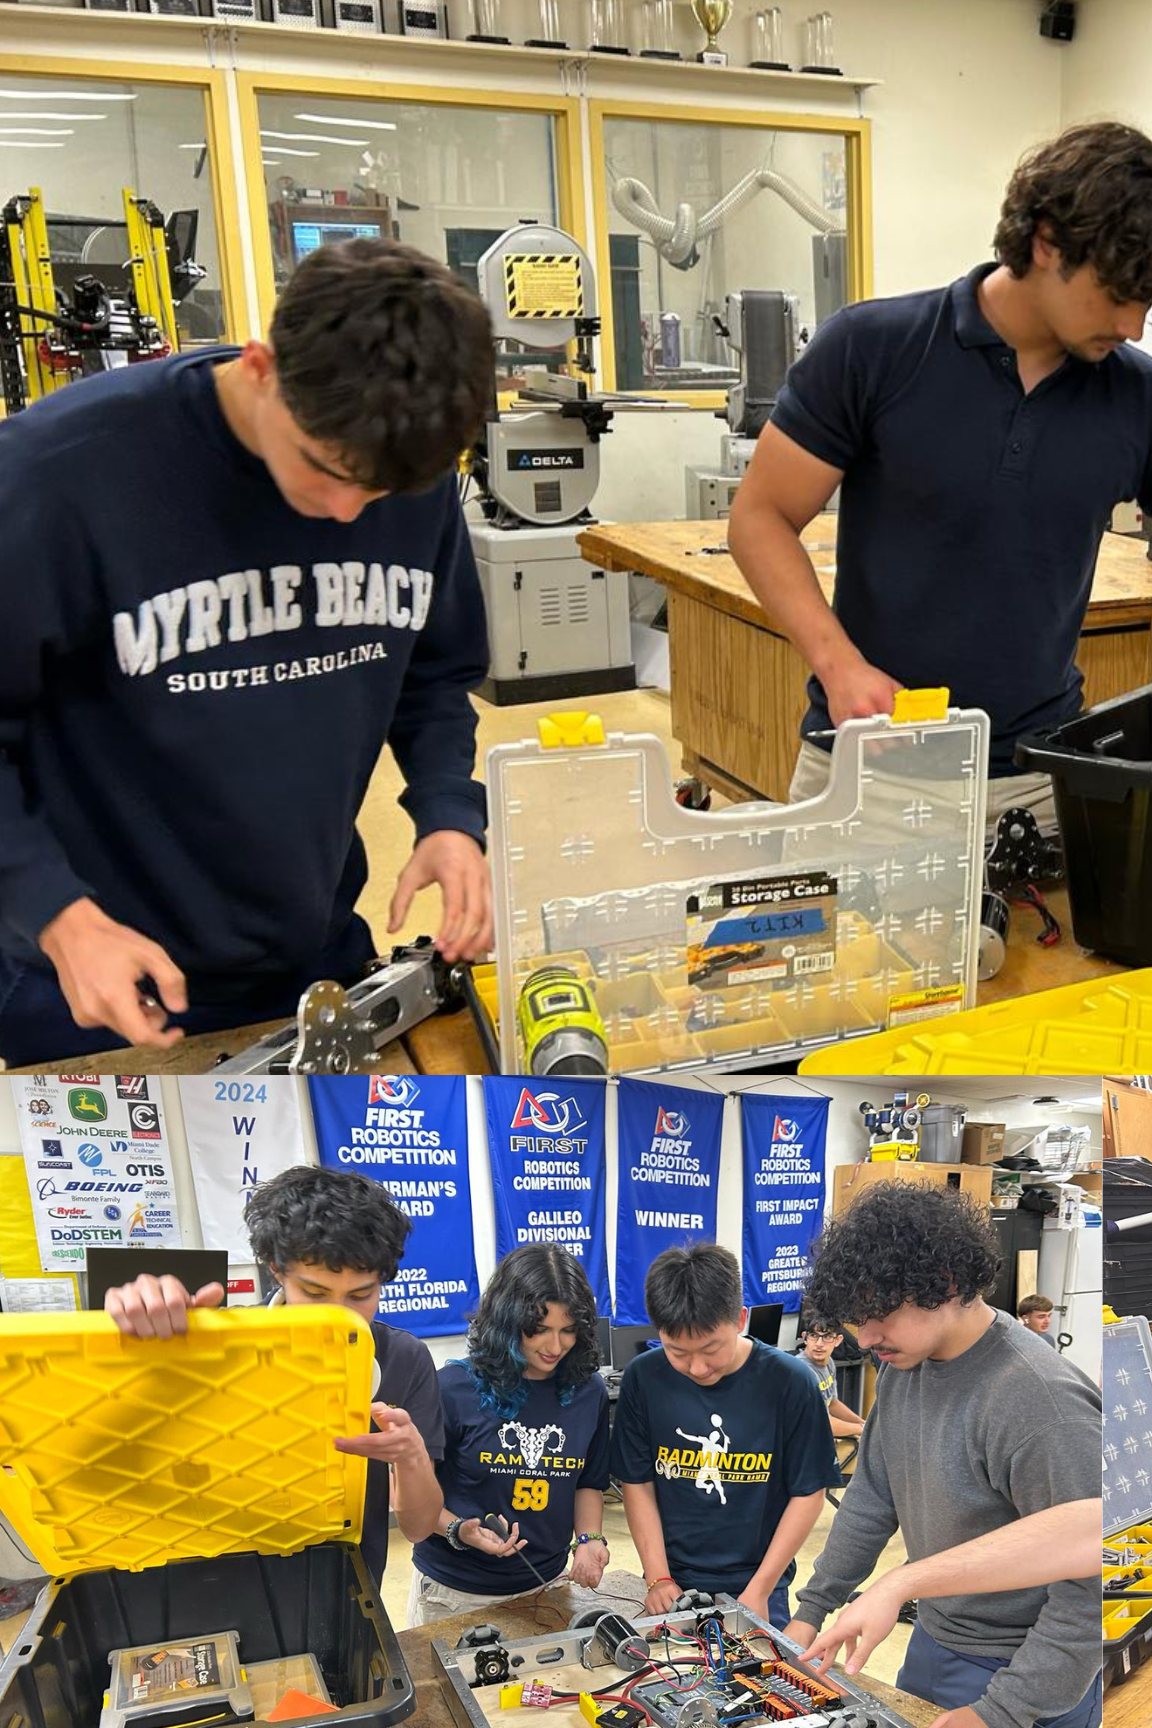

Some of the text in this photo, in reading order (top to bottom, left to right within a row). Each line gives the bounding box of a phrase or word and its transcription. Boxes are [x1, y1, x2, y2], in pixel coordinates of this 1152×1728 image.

[531, 456, 574, 467] DELTA
[113, 561, 434, 677] MYRTLE BEACH
[167, 641, 387, 693] SOUTH CAROLINA
[756, 881, 788, 891] Portable
[790, 878, 810, 887] Parts
[731, 889, 790, 905] Storage
[794, 883, 829, 897] Case
[214, 1081, 267, 1103] 2024
[366, 1108, 424, 1128] FIRST
[56, 1125, 128, 1138] JOHN DEERE
[351, 1128, 441, 1147] ROBOTICS
[510, 1136, 588, 1154] FIRST
[650, 1137, 692, 1155] FIRST
[770, 1143, 804, 1158] FIRST
[338, 1147, 457, 1166] COMPETITION
[640, 1152, 700, 1171] ROBOTICS
[92, 1168, 117, 1176] FPL
[126, 1164, 165, 1177] OTIS
[524, 1160, 580, 1175] ROBOTICS
[761, 1158, 811, 1171] ROBOTICS
[513, 1176, 591, 1190] COMPETITION
[630, 1167, 710, 1187] COMPETITION
[754, 1172, 821, 1185] COMPETITION
[64, 1181, 144, 1193] BOEING
[383, 1181, 457, 1198] IRMAN'S
[100, 1196, 121, 1204] Family
[756, 1199, 819, 1212] FIRST IMPACT
[57, 1207, 86, 1215] Ryder
[395, 1200, 435, 1217] ARD
[527, 1211, 582, 1226] GALILEO
[635, 1209, 703, 1229] WINNER
[769, 1213, 803, 1226] AWARD
[517, 1227, 592, 1243] DIVISIONAL
[775, 1245, 799, 1257] 2023
[394, 1268, 427, 1282] 2022
[379, 1280, 467, 1299] UTH FLORIDA
[767, 1280, 805, 1293] REGION
[378, 1296, 449, 1314] REGIONAL
[480, 1451, 585, 1470] RAM TECH
[658, 1446, 772, 1471] BADMINTON
[489, 1467, 517, 1475] MIAMI
[519, 1468, 548, 1477] CORAL
[511, 1478, 550, 1512] 59
